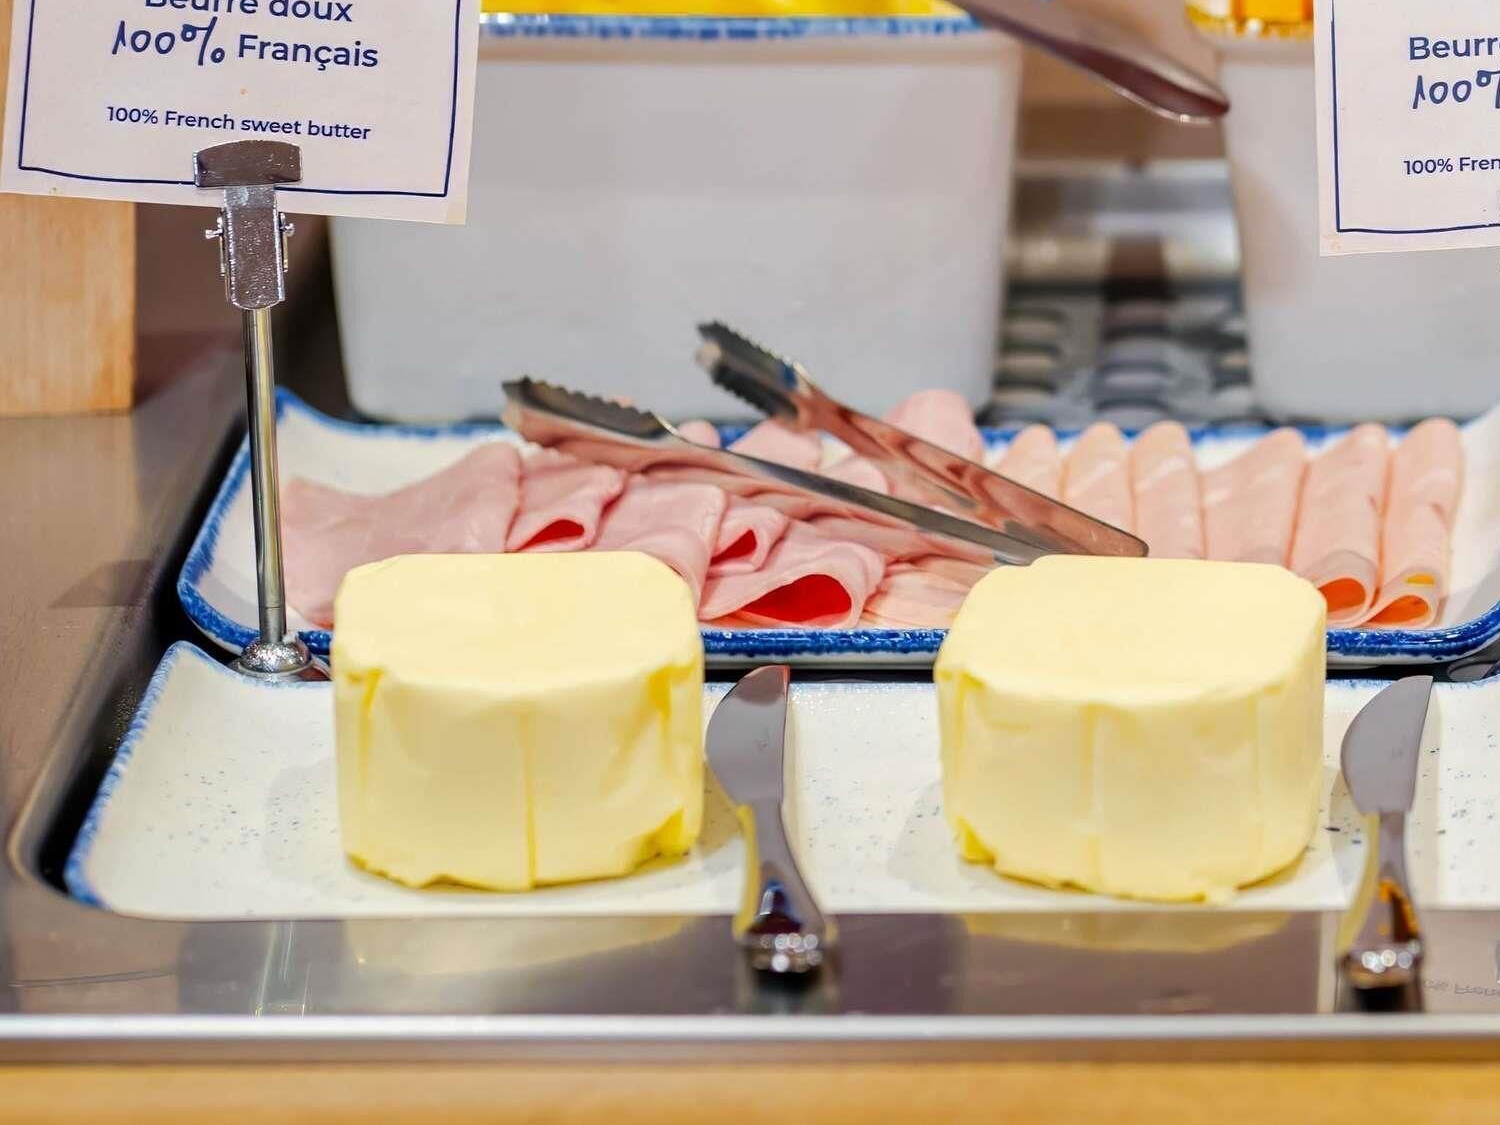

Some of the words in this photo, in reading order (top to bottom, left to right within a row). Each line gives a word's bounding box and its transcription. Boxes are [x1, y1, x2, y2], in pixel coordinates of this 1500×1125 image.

[111, 15, 226, 67] 100%
[238, 33, 379, 72] Français
[107, 106, 159, 125] 100%
[164, 110, 235, 131] French
[240, 119, 302, 135] sweet
[307, 119, 372, 140] butter
[1403, 157, 1454, 176] 100%
